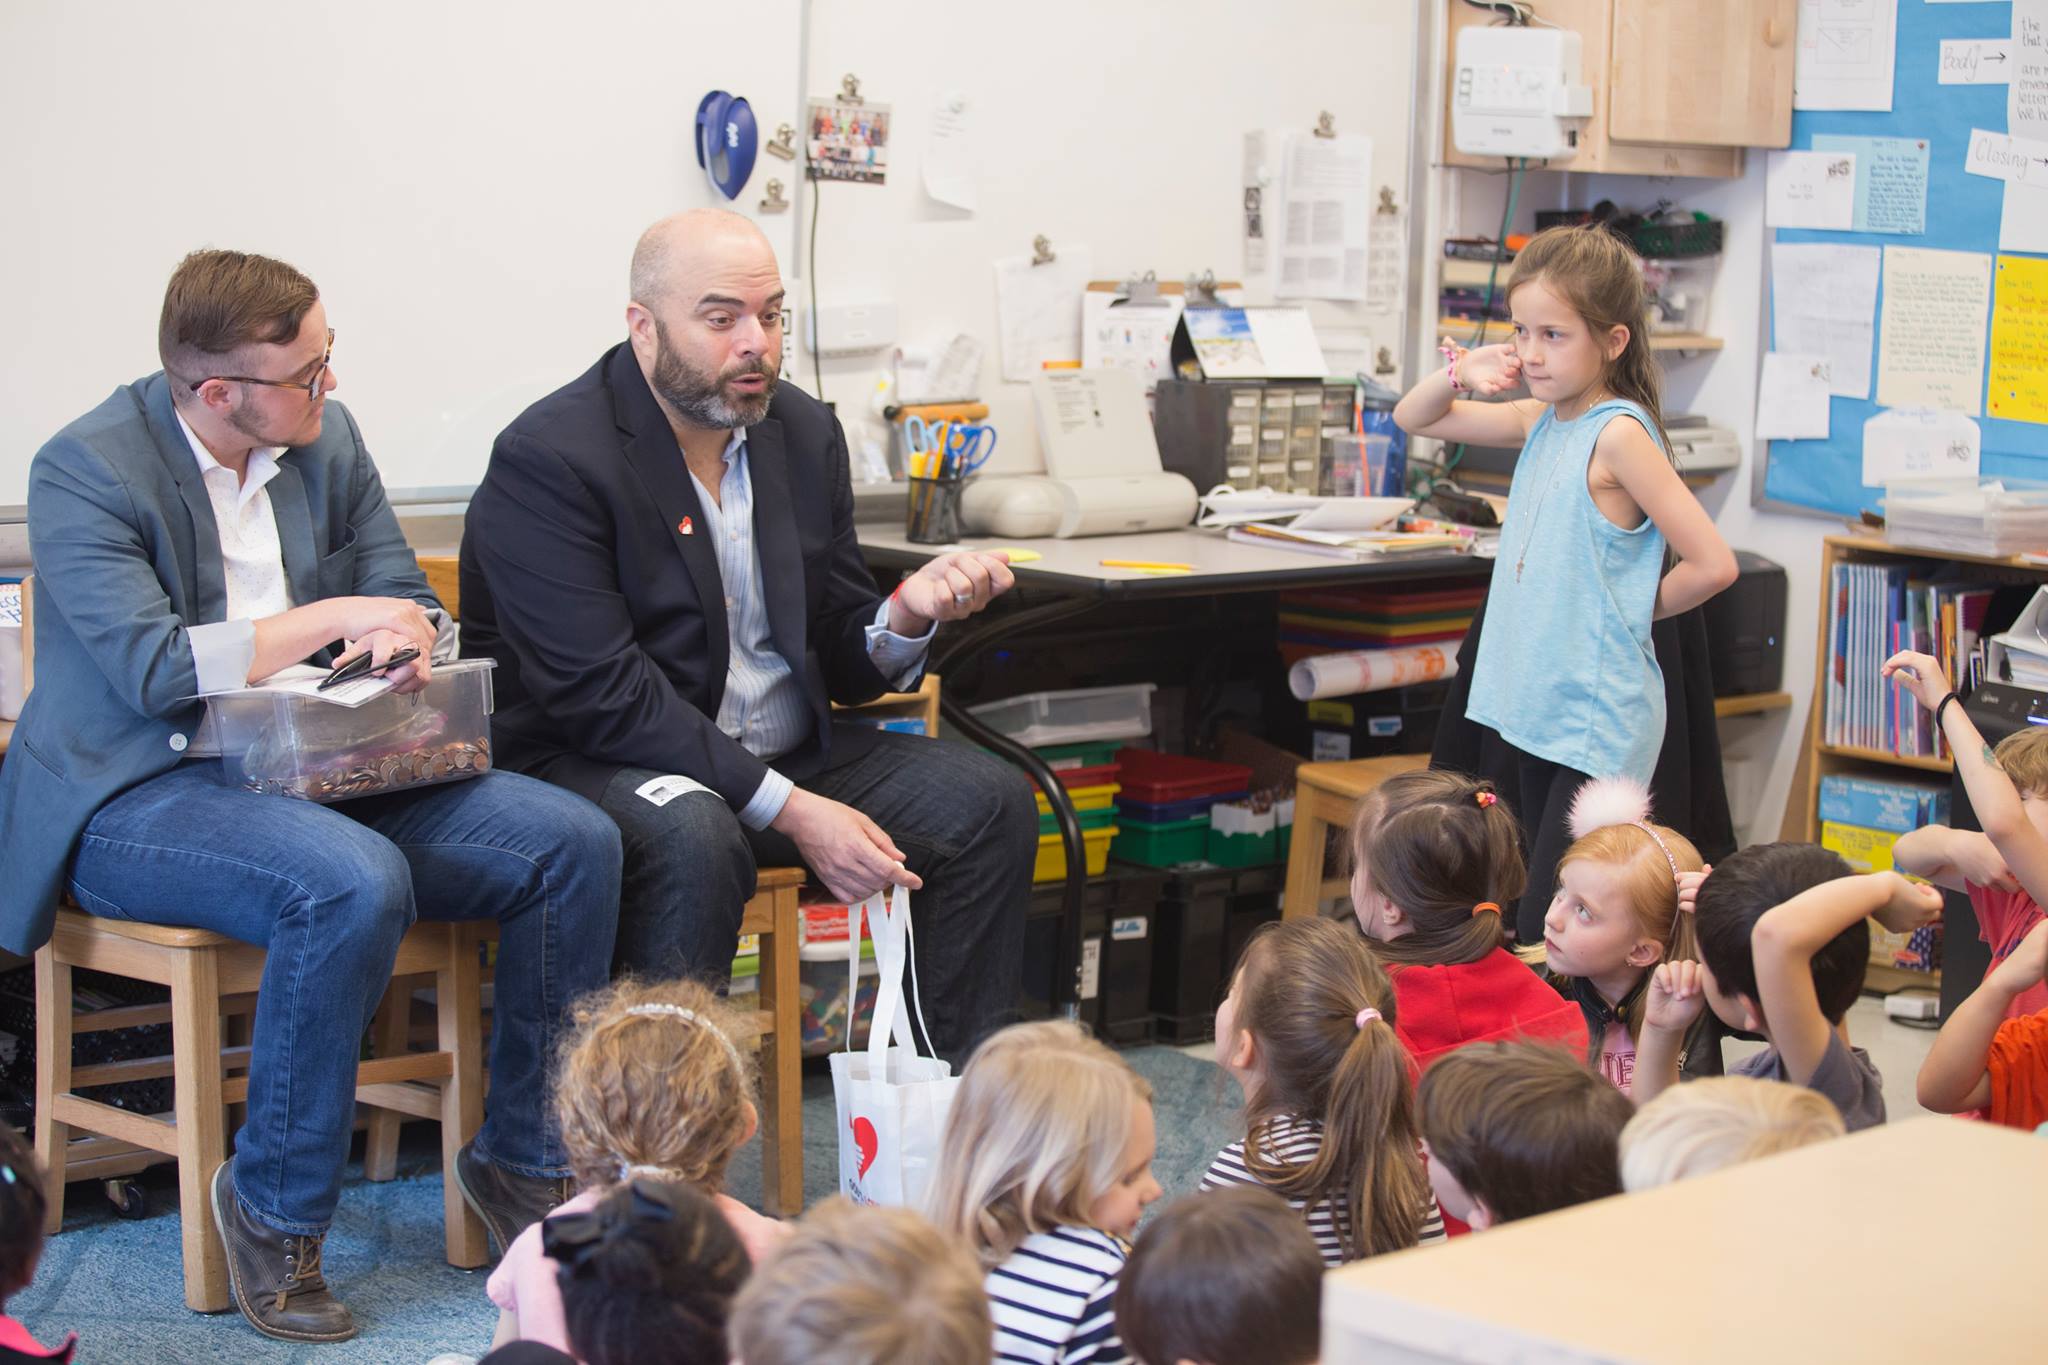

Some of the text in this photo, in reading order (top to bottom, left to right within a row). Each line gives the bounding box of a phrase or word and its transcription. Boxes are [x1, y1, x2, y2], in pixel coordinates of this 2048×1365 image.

[2022, 32, 2041, 48] that
[1942, 48, 1979, 81] Body
[1975, 137, 2028, 181] Closing
